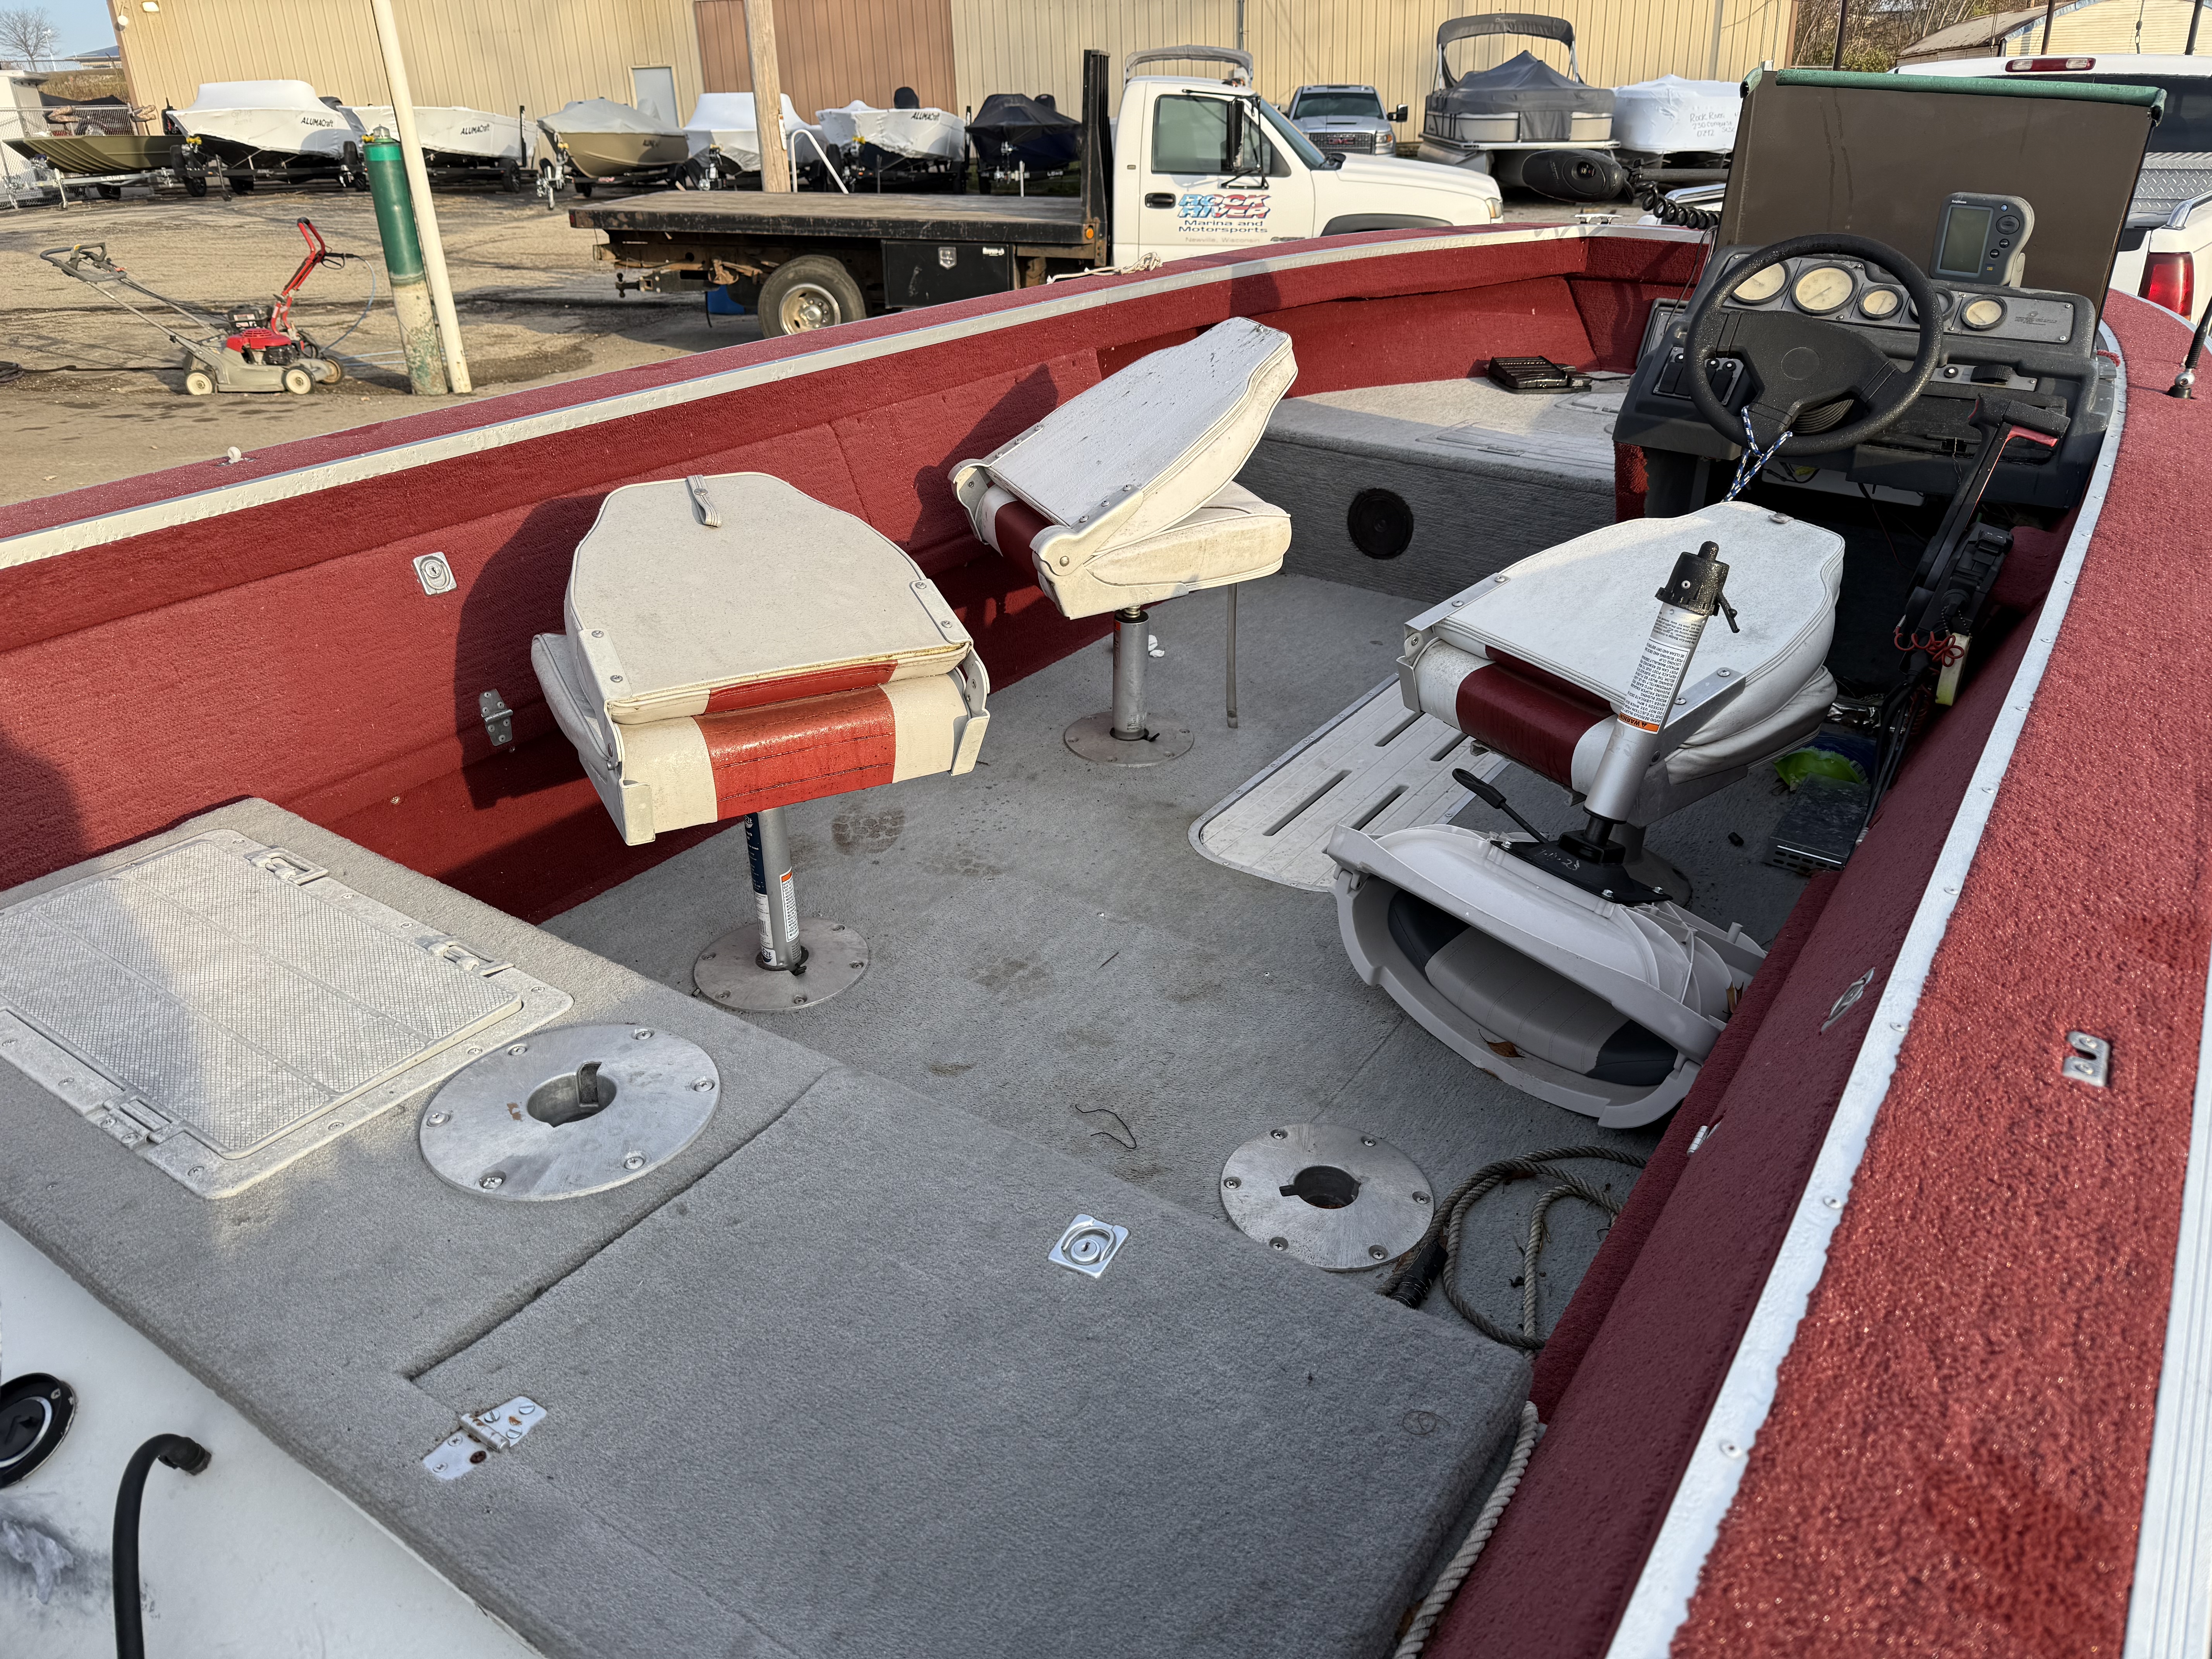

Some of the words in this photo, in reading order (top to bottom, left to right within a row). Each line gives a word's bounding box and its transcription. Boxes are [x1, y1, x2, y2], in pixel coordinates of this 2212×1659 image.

[1690, 113, 1707, 122] Rock
[1178, 194, 1271, 206] ROCK
[1178, 205, 1271, 218] RIVER
[1618, 713, 1640, 726] WARNIN
